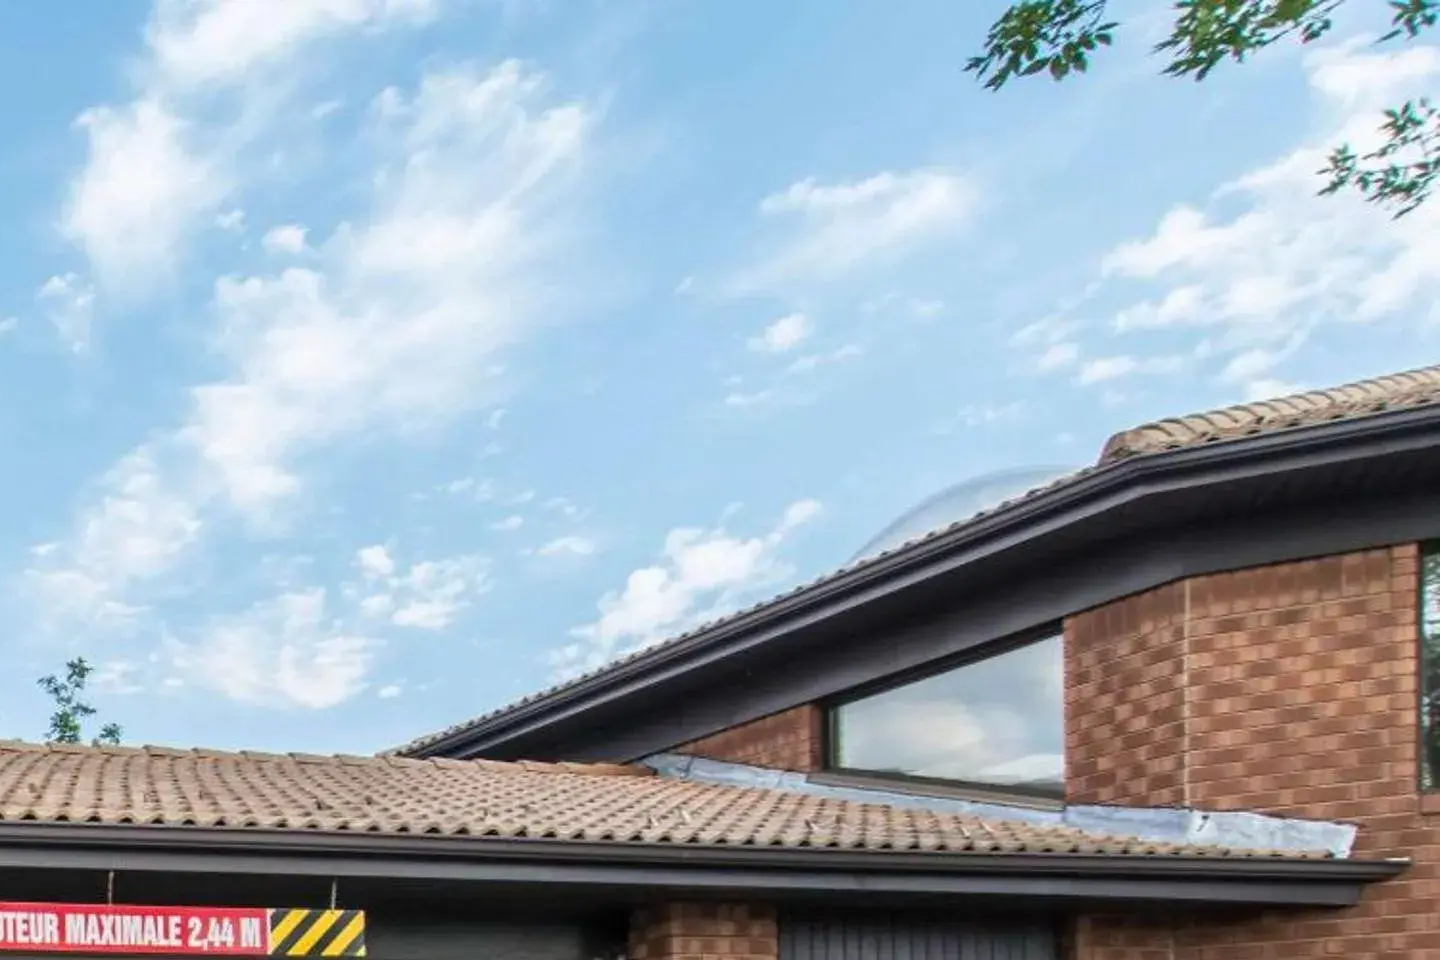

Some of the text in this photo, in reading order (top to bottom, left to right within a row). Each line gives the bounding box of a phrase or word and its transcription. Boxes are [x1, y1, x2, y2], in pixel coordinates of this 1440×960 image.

[66, 912, 182, 947] MAXIMALE
[188, 918, 234, 951] 2,44
[240, 920, 262, 948] M
